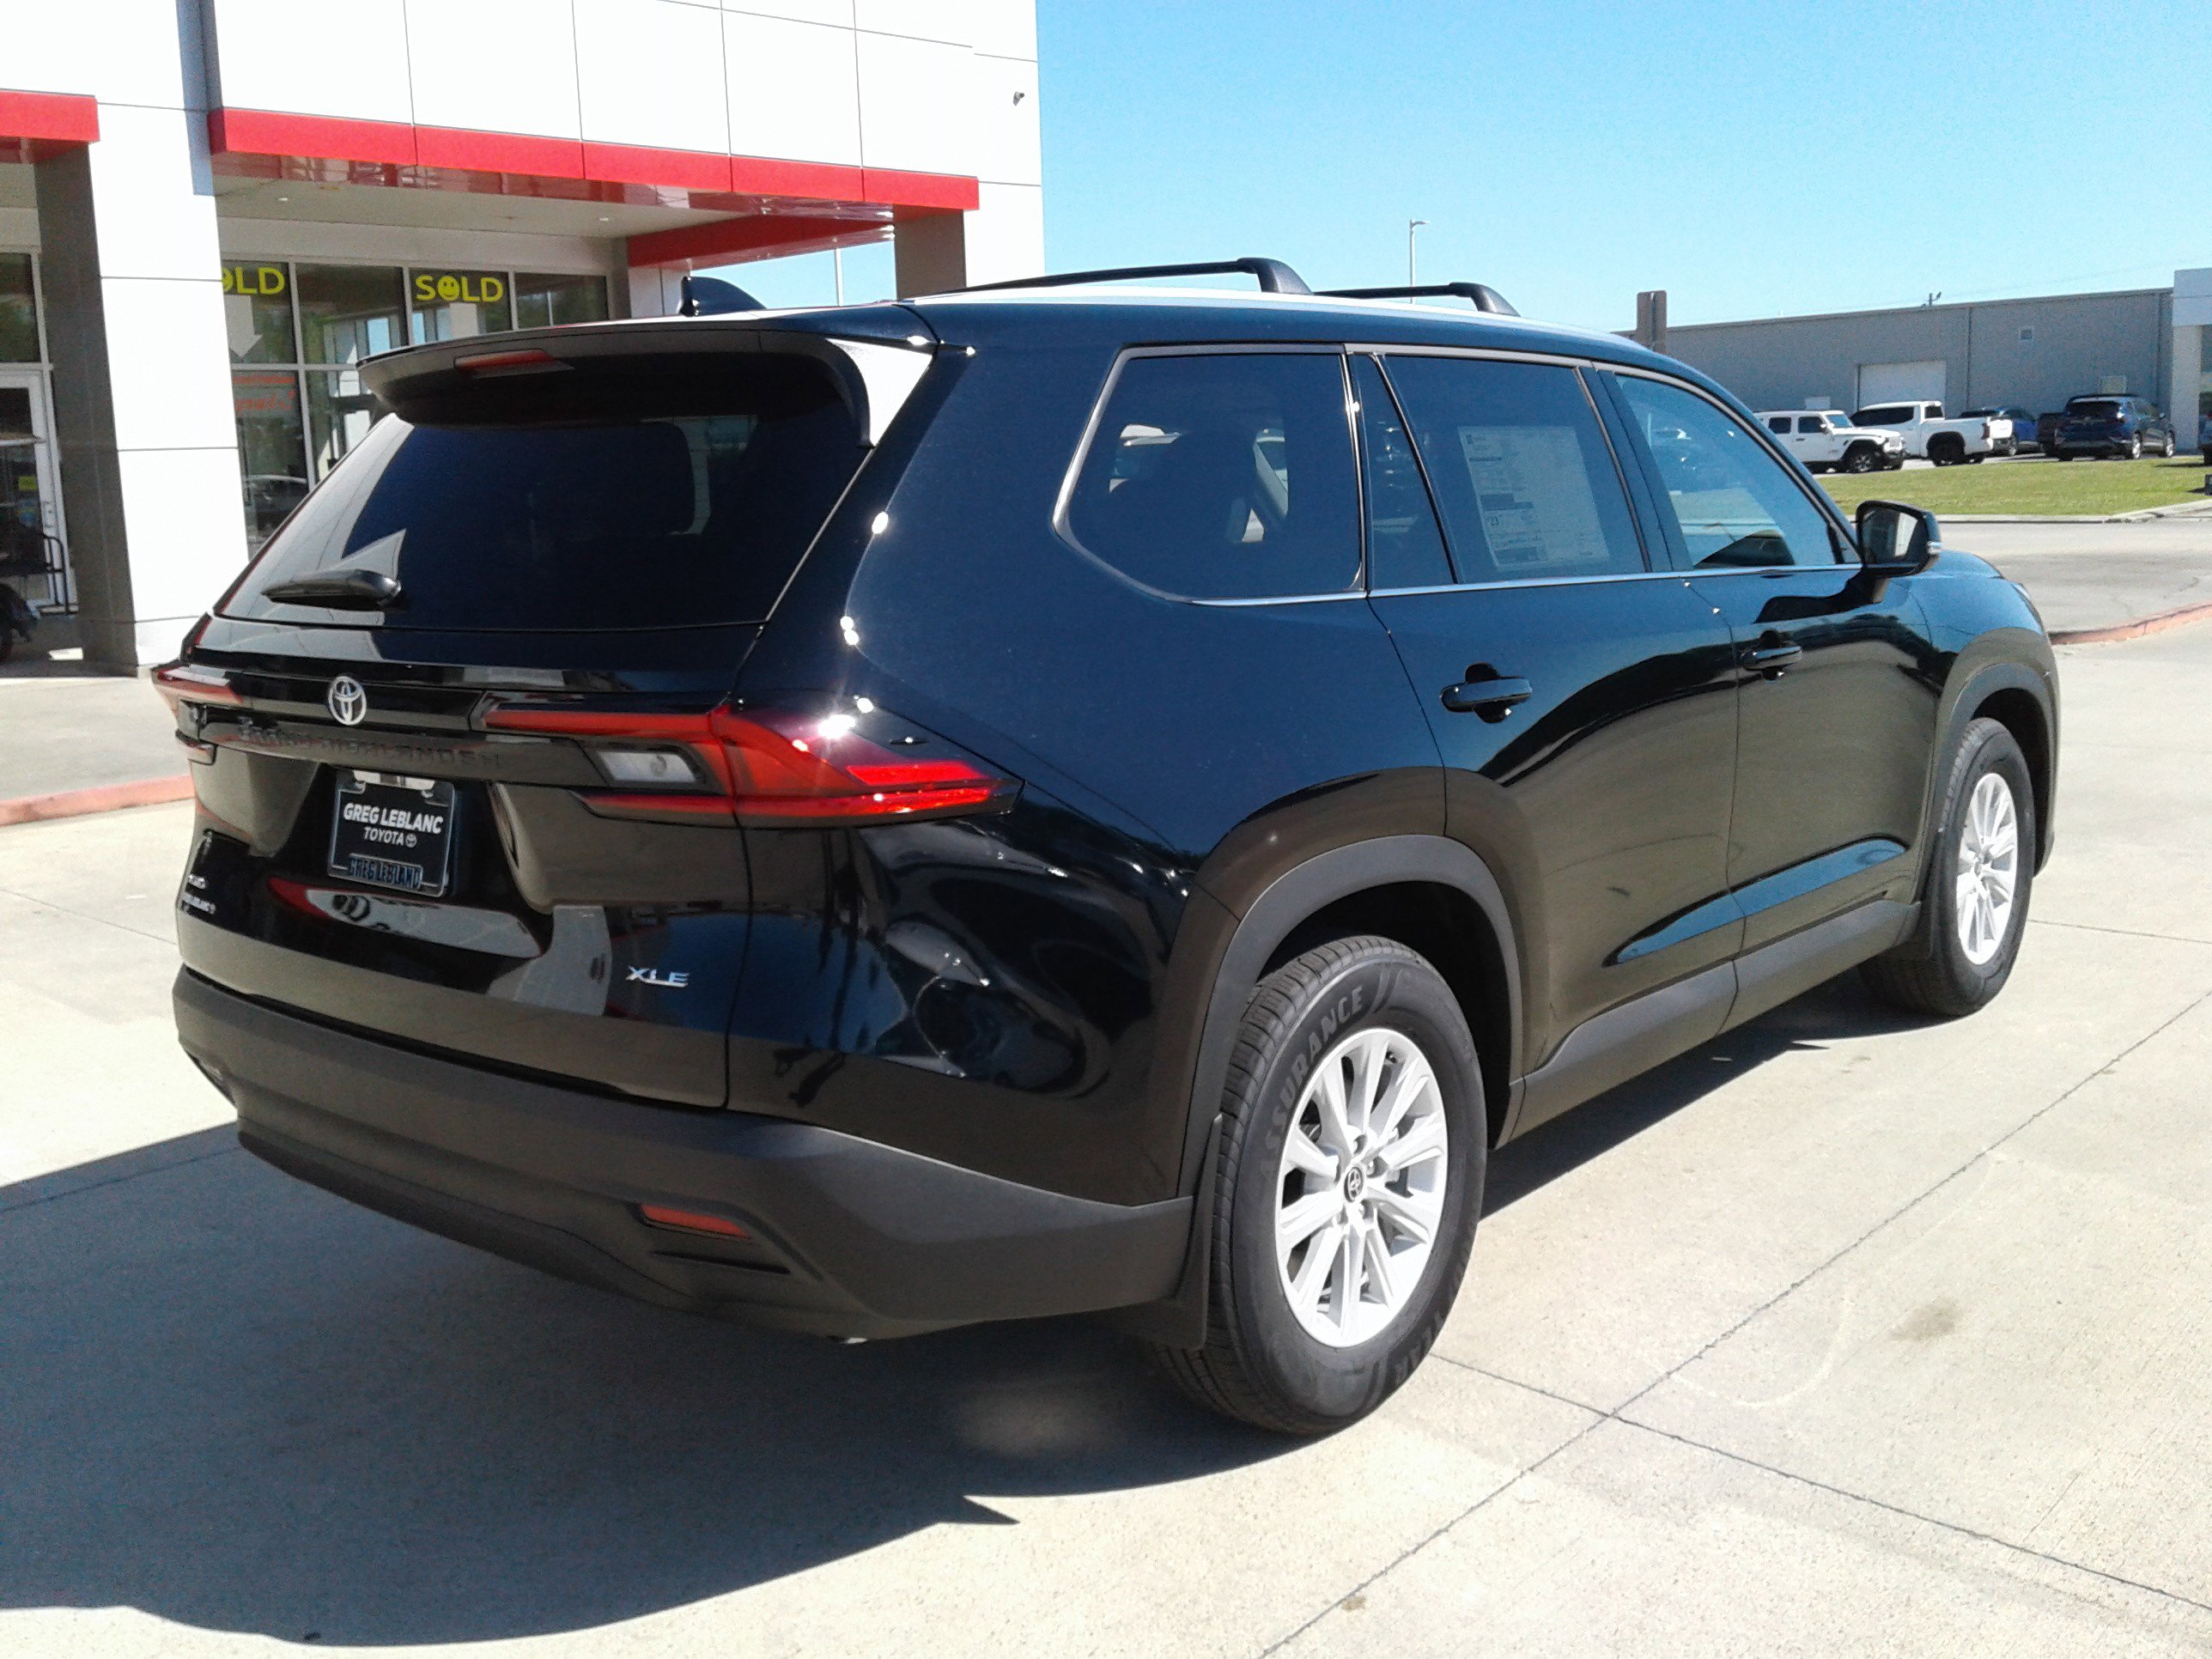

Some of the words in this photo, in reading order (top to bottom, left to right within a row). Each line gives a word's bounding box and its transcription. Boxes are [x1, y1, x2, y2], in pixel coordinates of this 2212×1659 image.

[221, 266, 285, 295] OLD
[415, 275, 504, 302] SOLD
[343, 803, 380, 824] GREG
[380, 807, 444, 835] LEBLANC
[363, 827, 404, 846] TOYOTA
[625, 965, 690, 988] XLE
